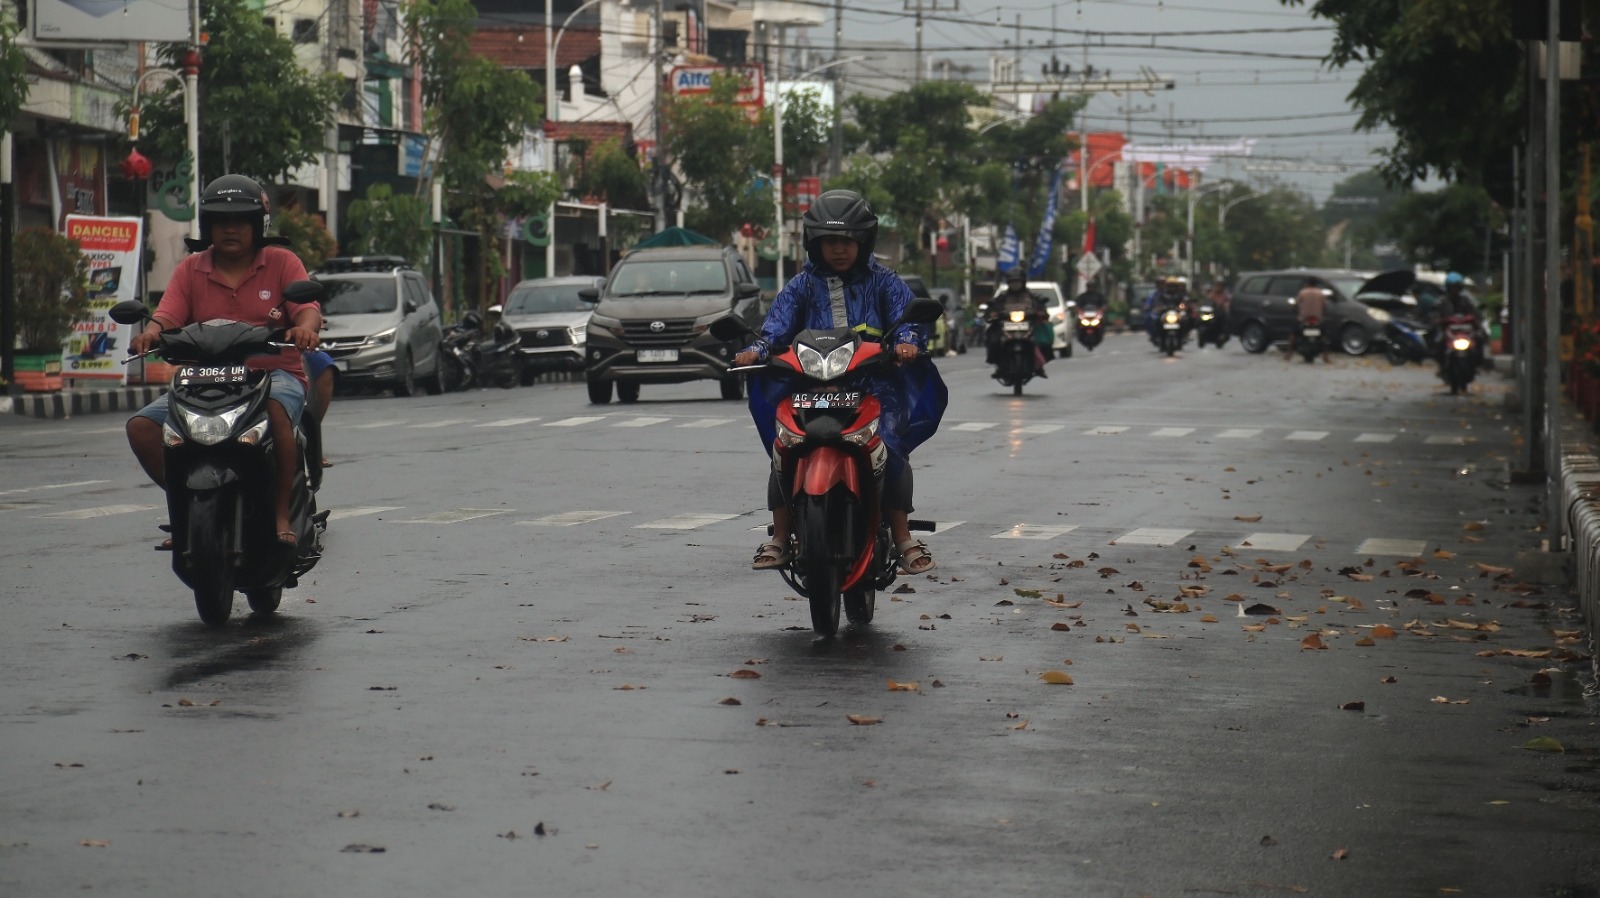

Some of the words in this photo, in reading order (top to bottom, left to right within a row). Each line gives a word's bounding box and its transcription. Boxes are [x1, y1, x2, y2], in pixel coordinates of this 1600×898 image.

[73, 225, 131, 238] DANCELL
[180, 367, 194, 377] AG
[199, 367, 226, 377] 3064
[231, 366, 245, 375] UH
[794, 393, 808, 402] AG
[813, 393, 840, 402] 4404
[845, 392, 859, 401] XF
